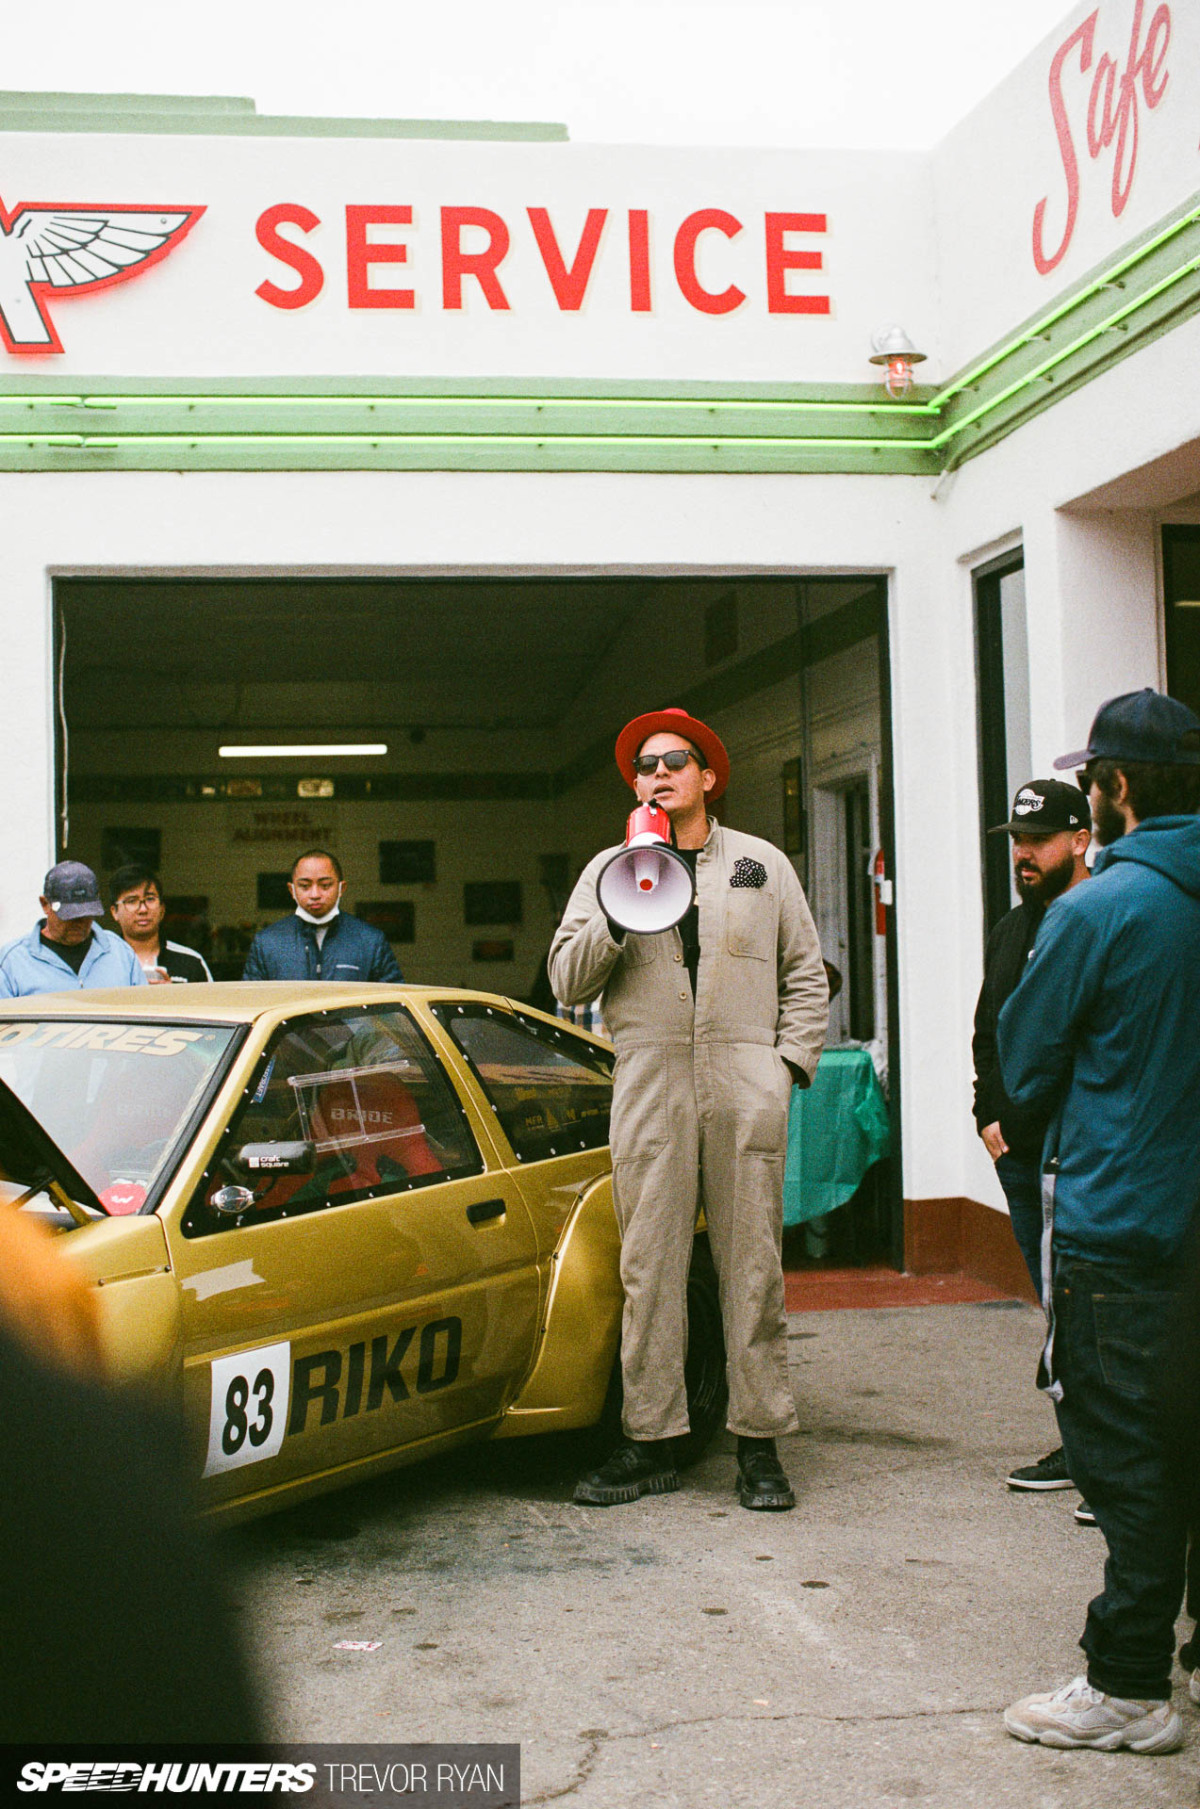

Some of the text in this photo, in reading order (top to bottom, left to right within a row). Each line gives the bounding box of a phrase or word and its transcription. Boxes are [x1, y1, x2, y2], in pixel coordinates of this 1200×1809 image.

[1032, 0, 1172, 275] Safe
[253, 202, 832, 315] SERVICE
[0, 1022, 205, 1056] O TIRES
[330, 1108, 393, 1124] BRIDE
[222, 1315, 463, 1456] 83 RIKO
